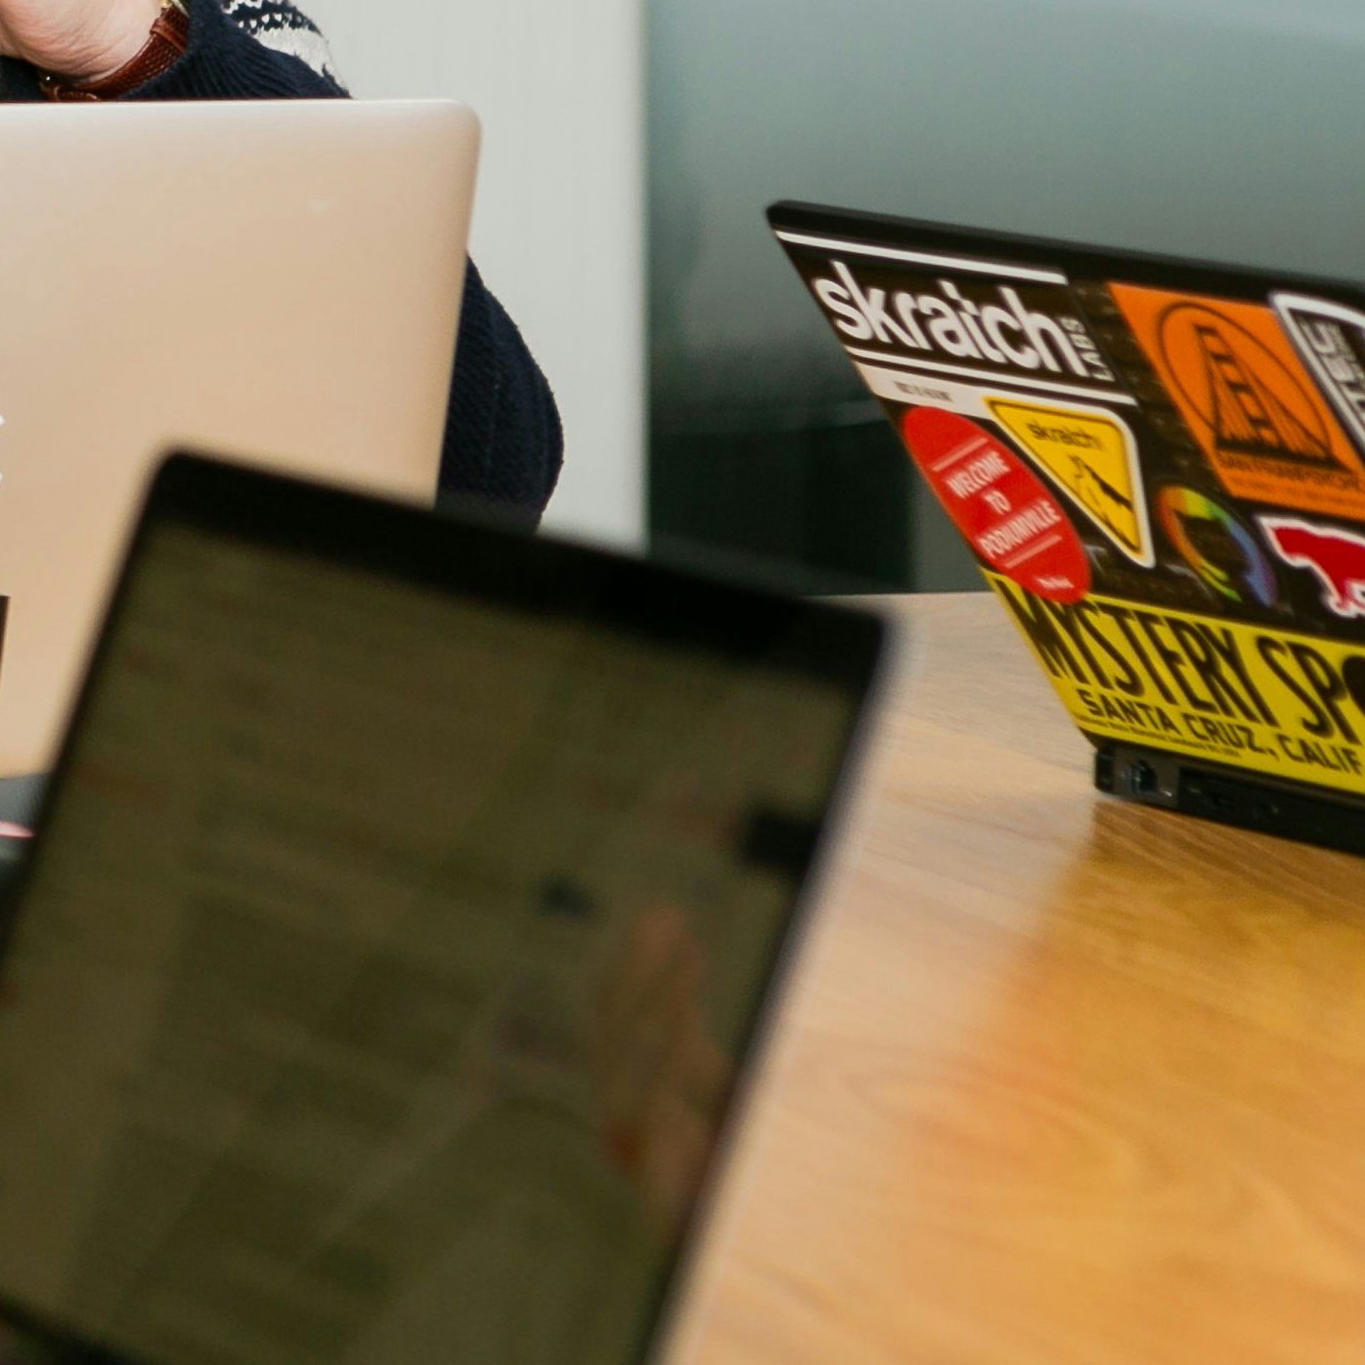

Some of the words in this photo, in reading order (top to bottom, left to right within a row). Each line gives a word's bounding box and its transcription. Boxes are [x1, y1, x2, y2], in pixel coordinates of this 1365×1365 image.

[812, 259, 1091, 378] skratch
[1059, 317, 1116, 382] LABS
[945, 449, 1012, 500] WELCOME
[982, 487, 1012, 515] TO
[993, 577, 1280, 728] MYSTERY
[1076, 688, 1183, 735] SANTA
[1182, 712, 1281, 762] CRUZ,
